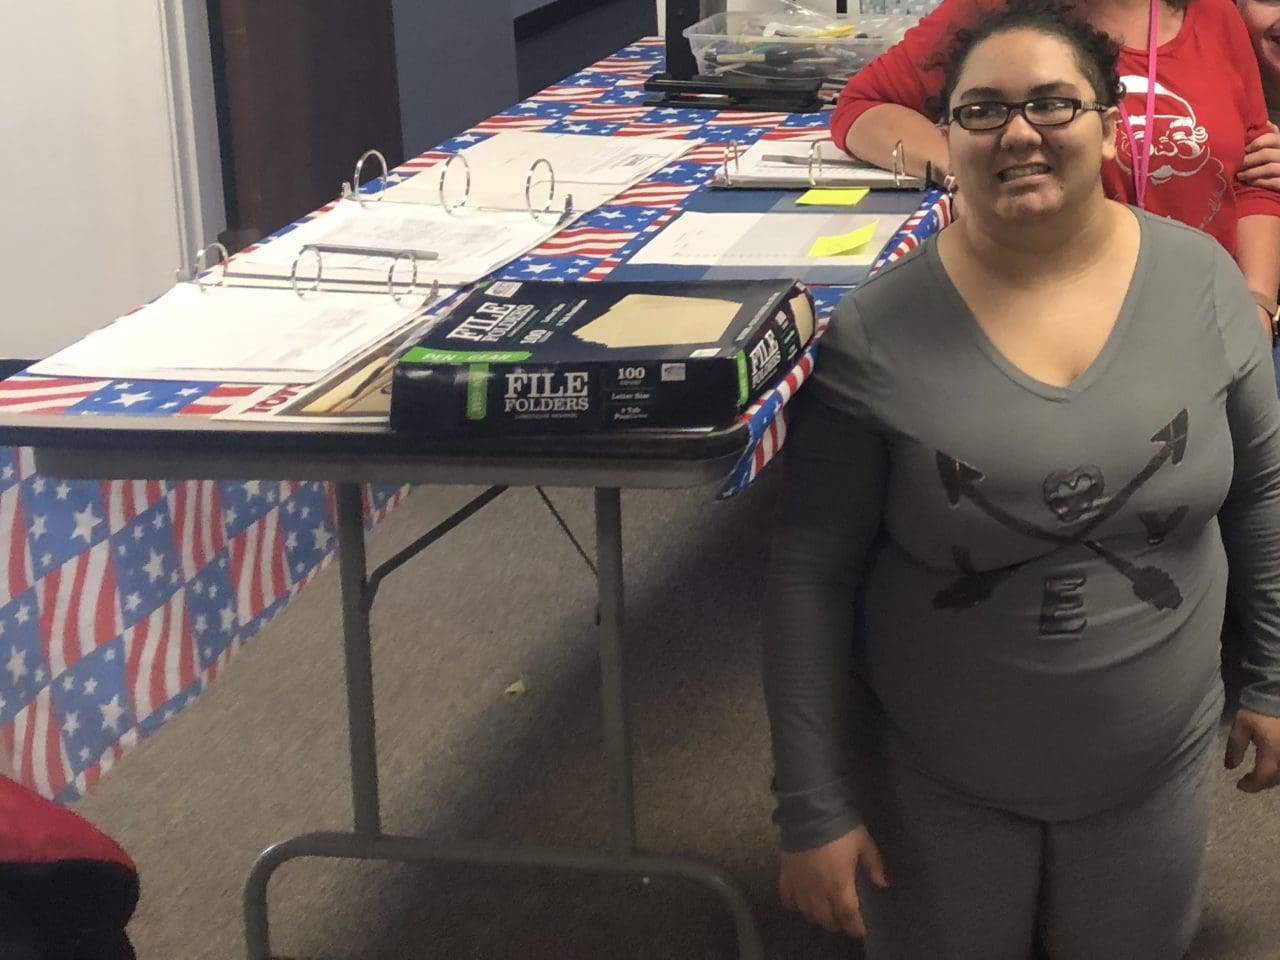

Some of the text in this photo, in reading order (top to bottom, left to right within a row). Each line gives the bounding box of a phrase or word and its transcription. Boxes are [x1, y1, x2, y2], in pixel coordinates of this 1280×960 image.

[446, 301, 516, 342] FILE
[750, 329, 779, 376] FILE
[504, 372, 588, 398] FILE
[617, 367, 645, 380] 100
[504, 397, 589, 412] FOLDERS
